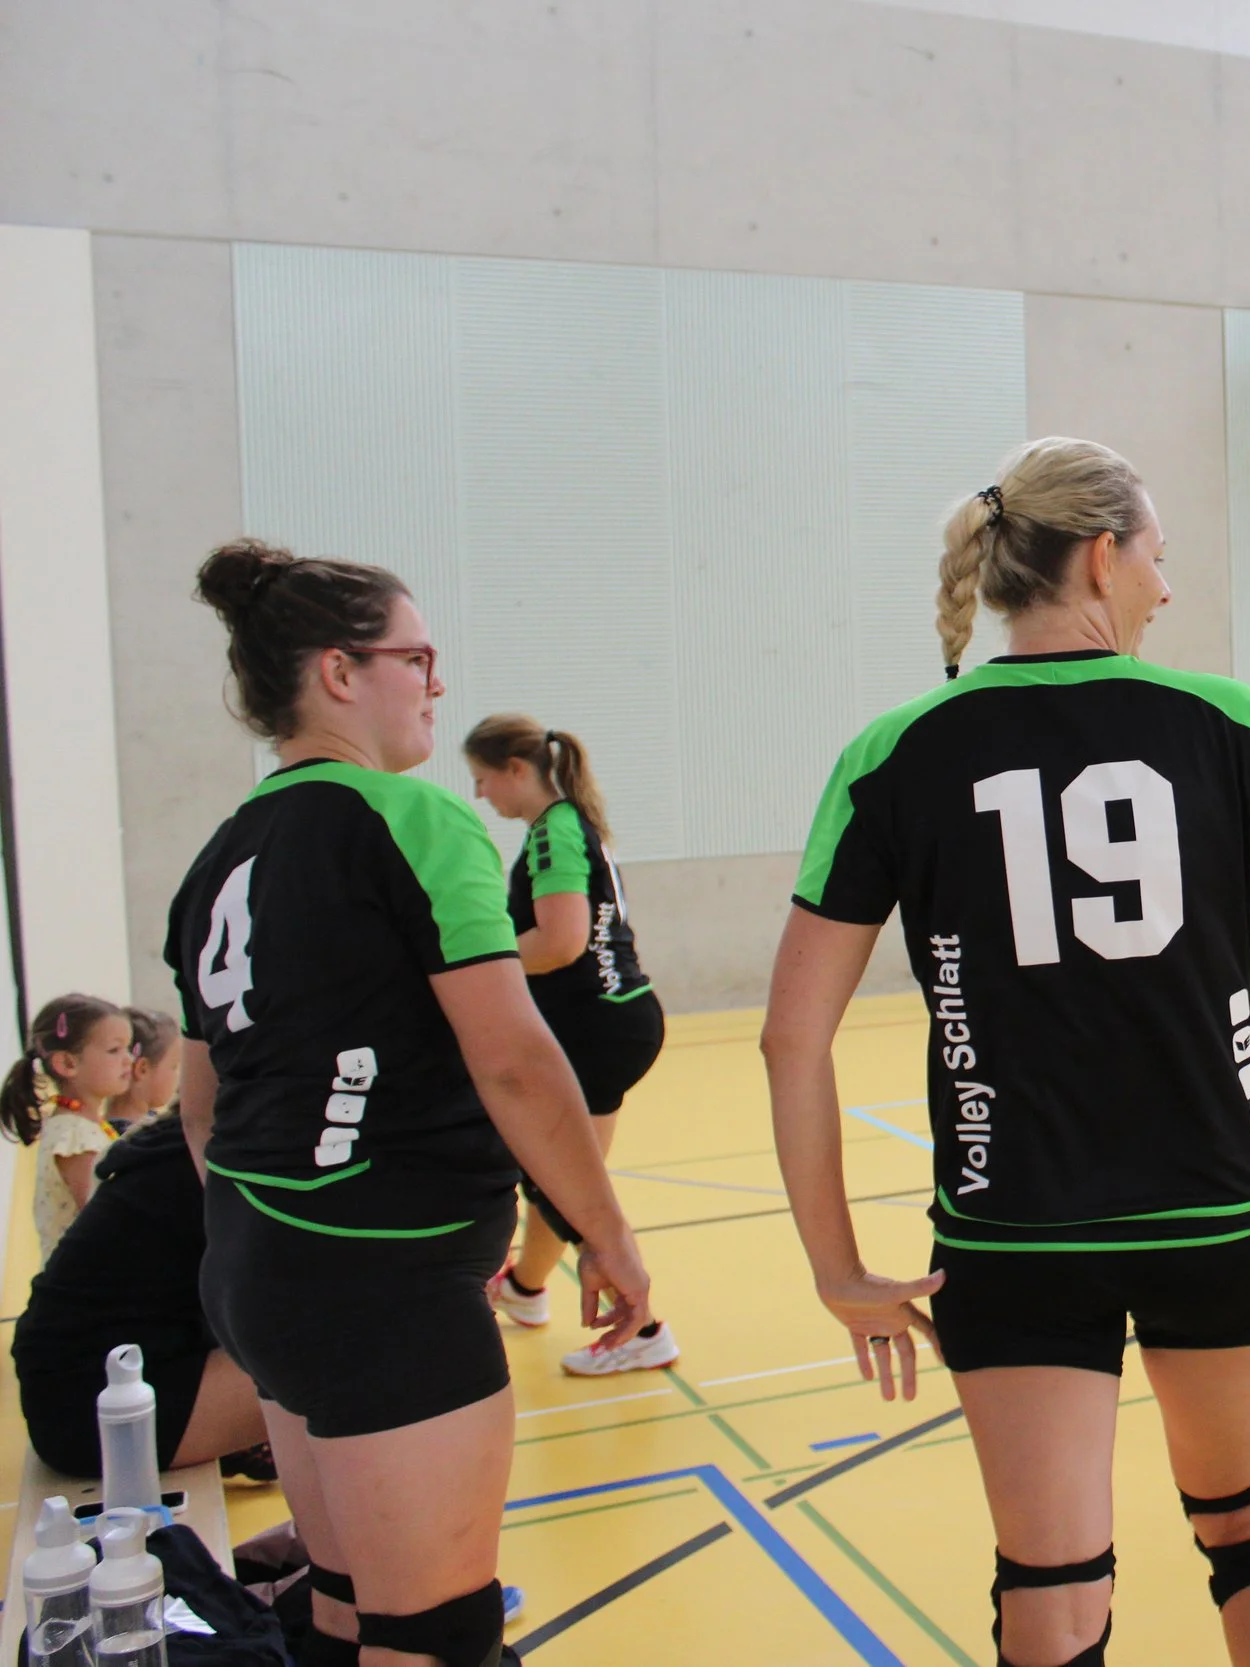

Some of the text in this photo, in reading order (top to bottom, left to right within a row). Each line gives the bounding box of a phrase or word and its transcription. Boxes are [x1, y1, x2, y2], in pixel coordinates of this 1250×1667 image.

[198, 855, 257, 1033] 4
[973, 760, 1184, 966] 19
[930, 934, 996, 1195] Volley Schlatt
